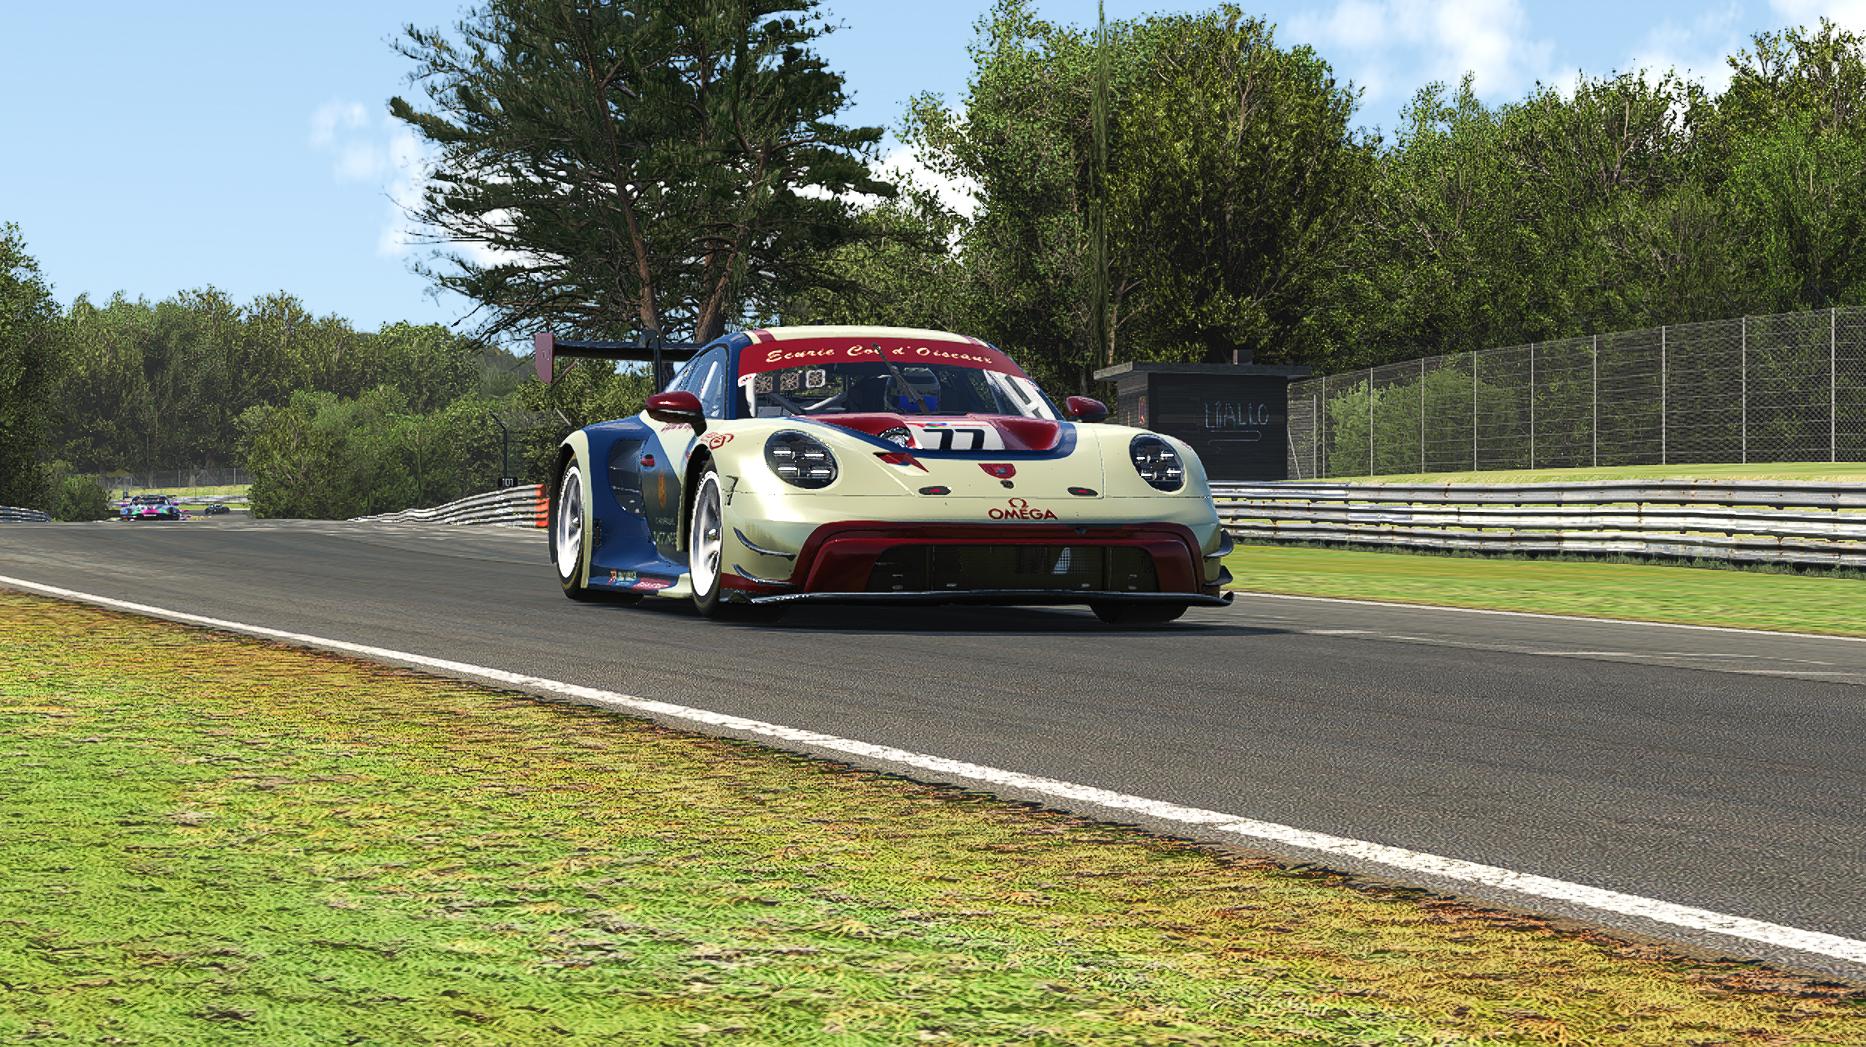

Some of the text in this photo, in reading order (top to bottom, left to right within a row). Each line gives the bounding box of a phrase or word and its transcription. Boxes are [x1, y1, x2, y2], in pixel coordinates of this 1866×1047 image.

[766, 348, 835, 363] Ecurie
[922, 428, 985, 450] 77
[988, 508, 1058, 521] OMEGA
